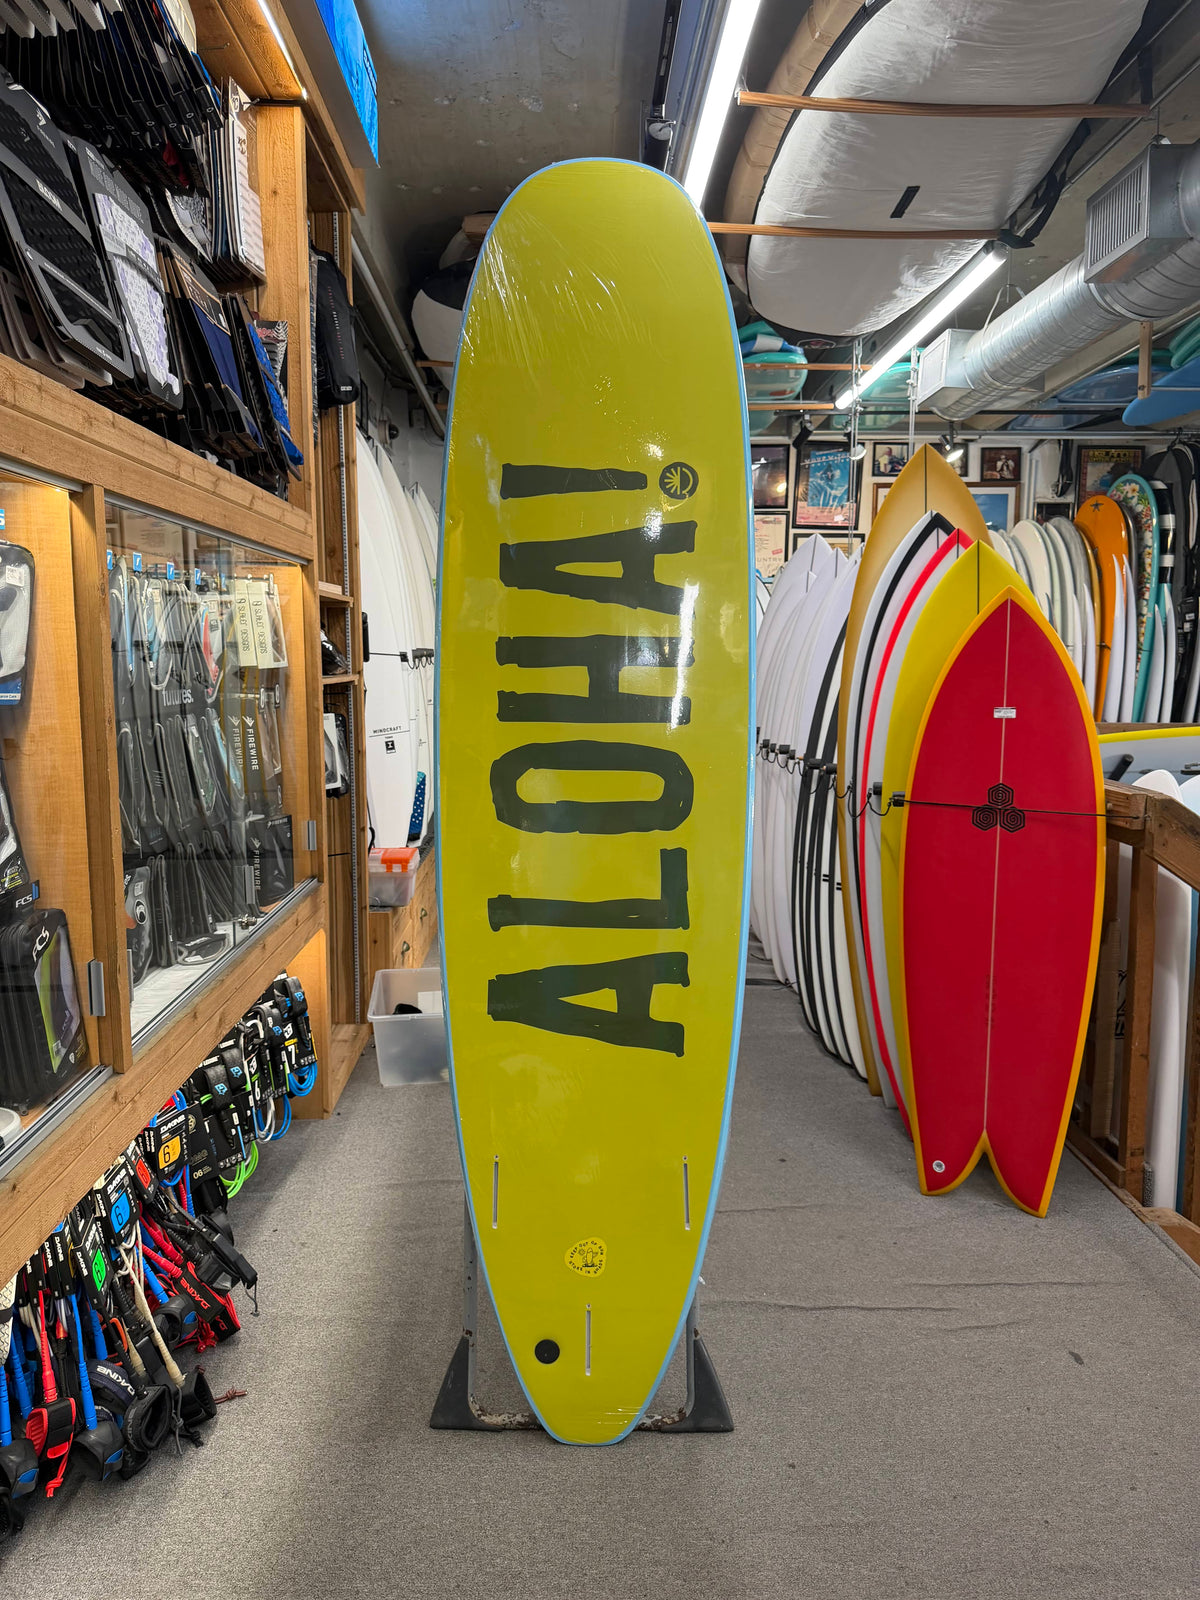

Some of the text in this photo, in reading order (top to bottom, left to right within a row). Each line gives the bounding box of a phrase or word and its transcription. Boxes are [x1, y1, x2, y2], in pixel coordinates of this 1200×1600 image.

[373, 726, 401, 734] MINDCRAFT
[246, 728, 259, 771] FIREWIRE
[488, 462, 699, 1057] ALOHA!
[252, 850, 261, 890] FIREWIRE
[15, 894, 32, 908] FCS
[32, 926, 49, 962] FCS
[287, 1045, 296, 1065] 7
[160, 1115, 186, 1134] DAKINE
[163, 1144, 171, 1164] 6
[107, 1168, 127, 1194] DAKINE
[96, 1193, 107, 1218] DAKINE
[115, 1205, 123, 1226] 6
[44, 1241, 53, 1268] DAKINE
[55, 1236, 64, 1262] DAKINE
[76, 1251, 88, 1277] DAKINE
[180, 1276, 211, 1310] DAKINE
[96, 1365, 135, 1396] DAKINE
[126, 1407, 138, 1449] KINE
